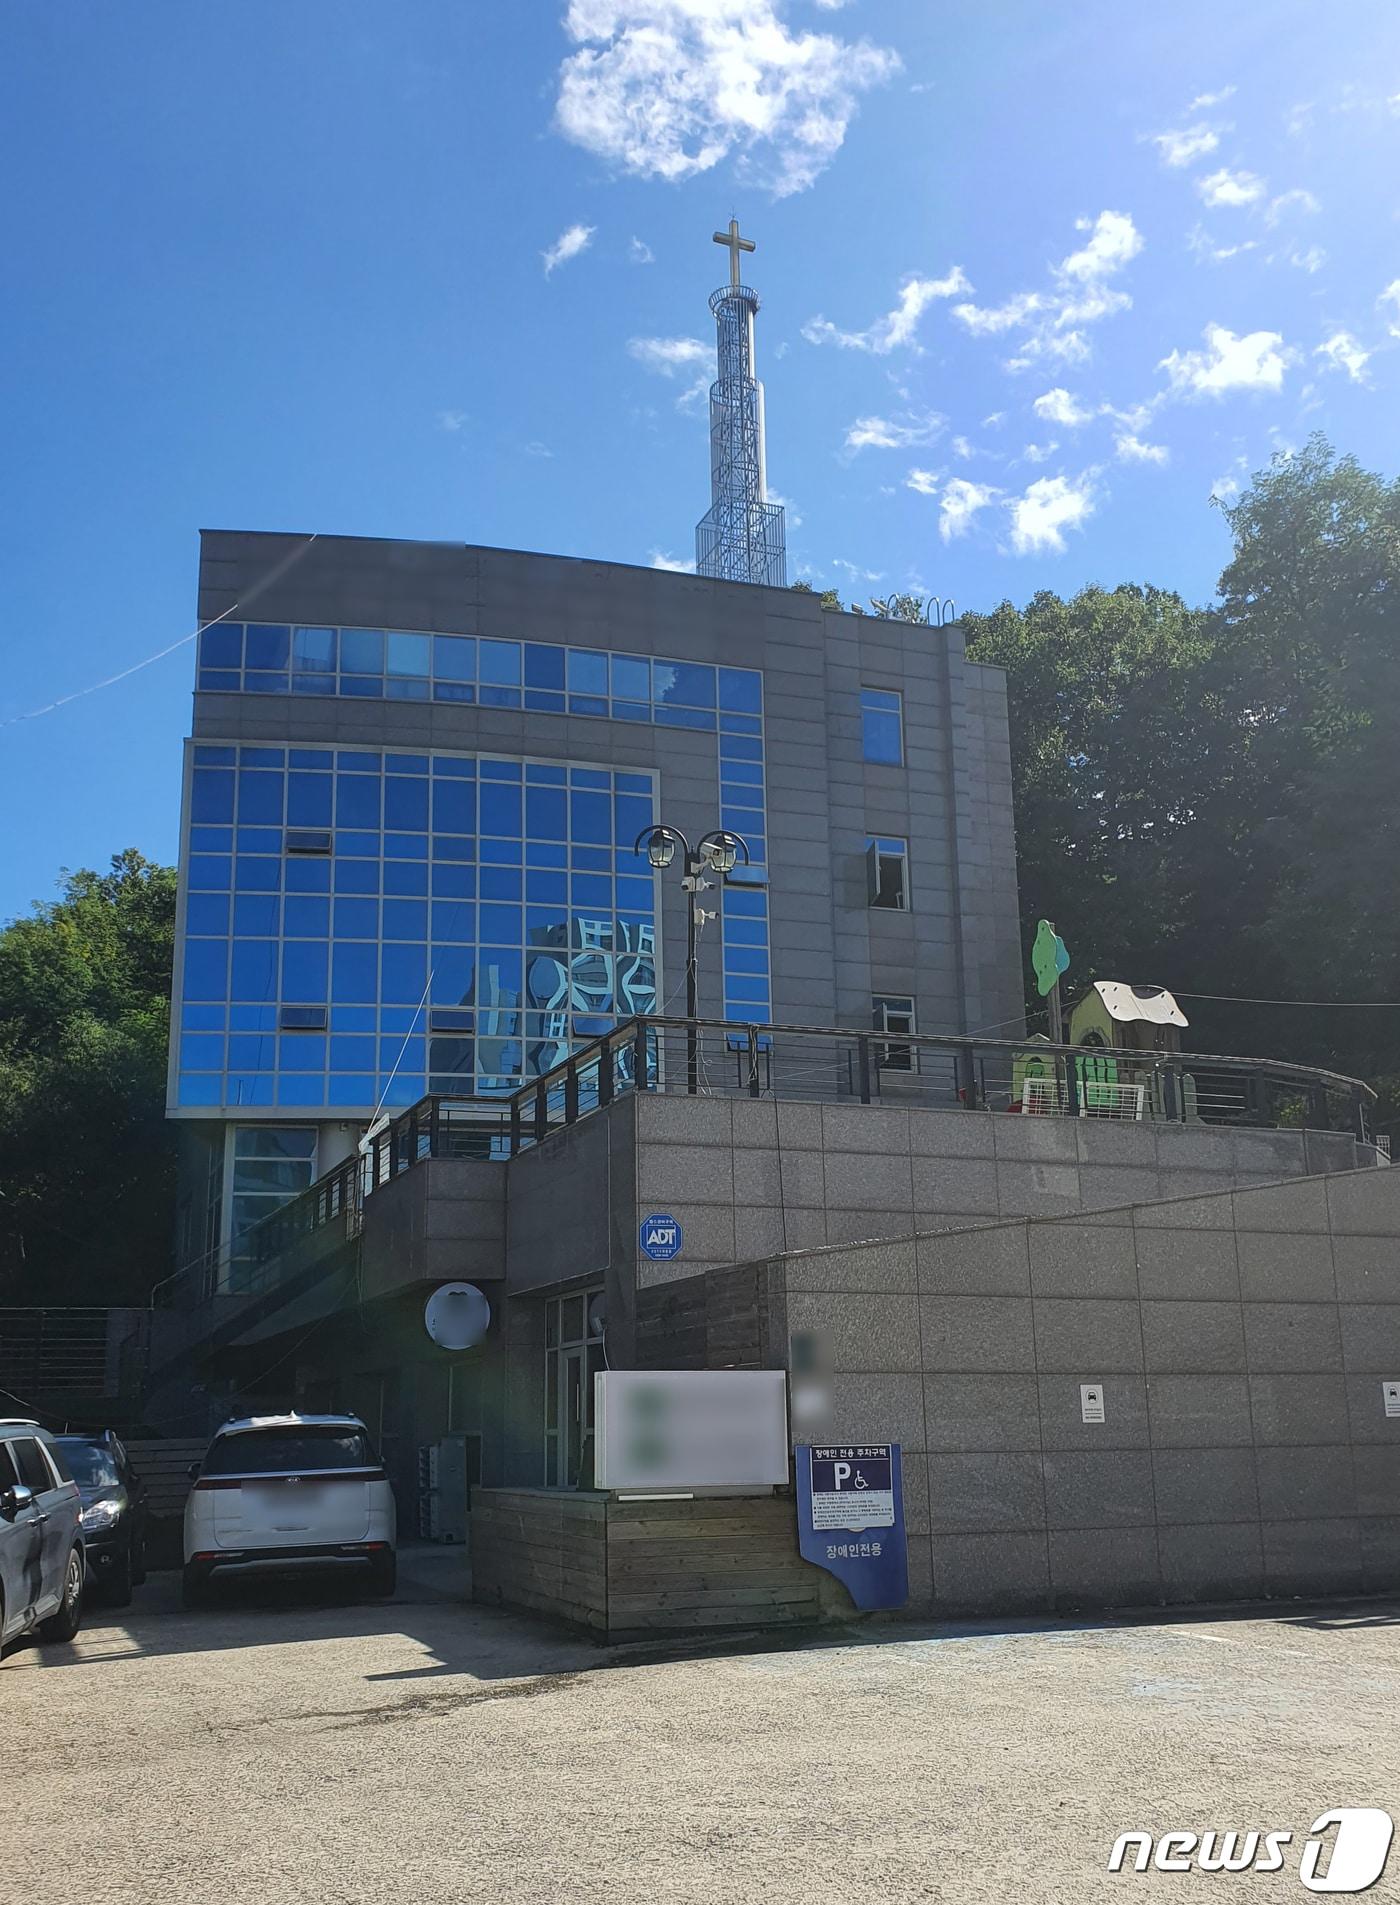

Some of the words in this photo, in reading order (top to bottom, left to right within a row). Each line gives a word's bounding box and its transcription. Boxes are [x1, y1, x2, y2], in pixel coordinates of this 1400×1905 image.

[648, 1229, 675, 1245] ADT
[815, 1449, 837, 1459] 장애인
[839, 1449, 854, 1458] 전용
[856, 1448, 887, 1457] 주차구역
[834, 1462, 851, 1490] P
[826, 1542, 882, 1559] 장애인전용
